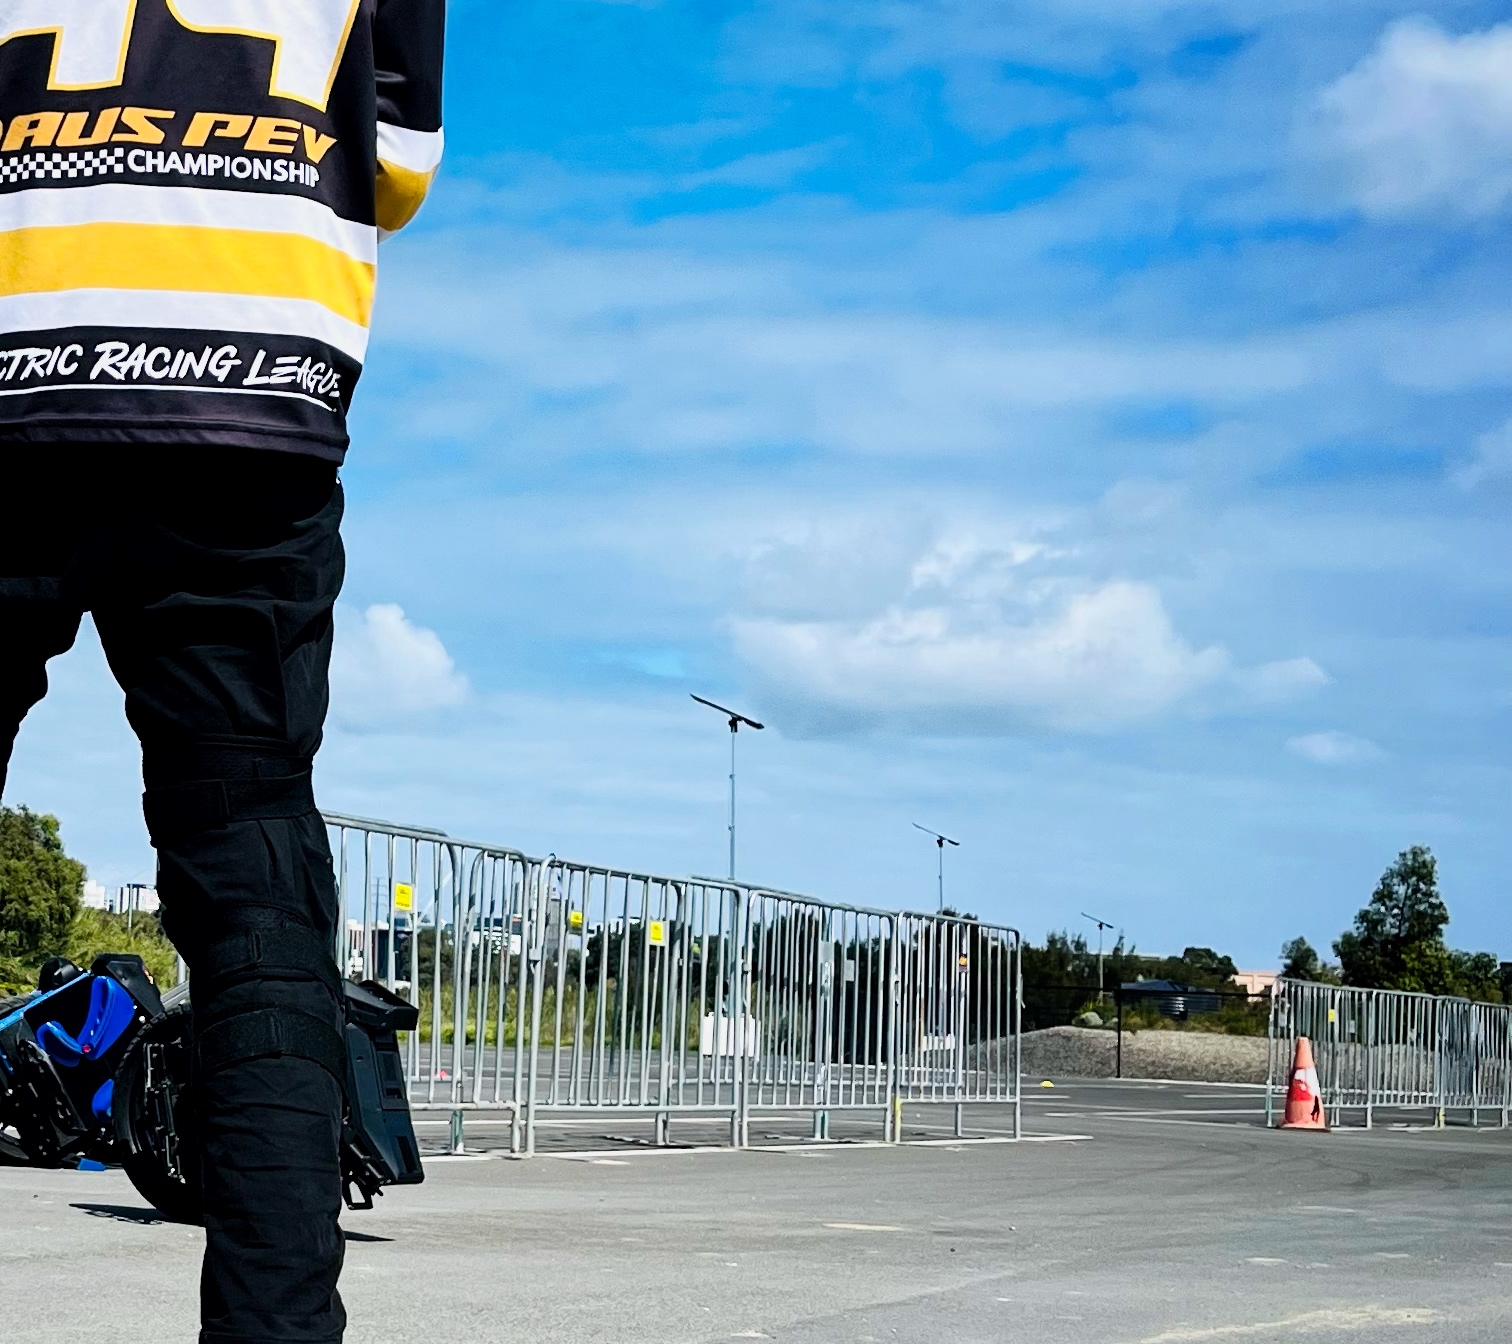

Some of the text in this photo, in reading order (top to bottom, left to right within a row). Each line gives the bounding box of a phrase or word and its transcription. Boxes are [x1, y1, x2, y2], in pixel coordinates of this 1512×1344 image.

[0, 107, 338, 164] AUS PEV
[127, 148, 320, 187] CHAMPIONSHIP
[90, 341, 243, 383] RACING
